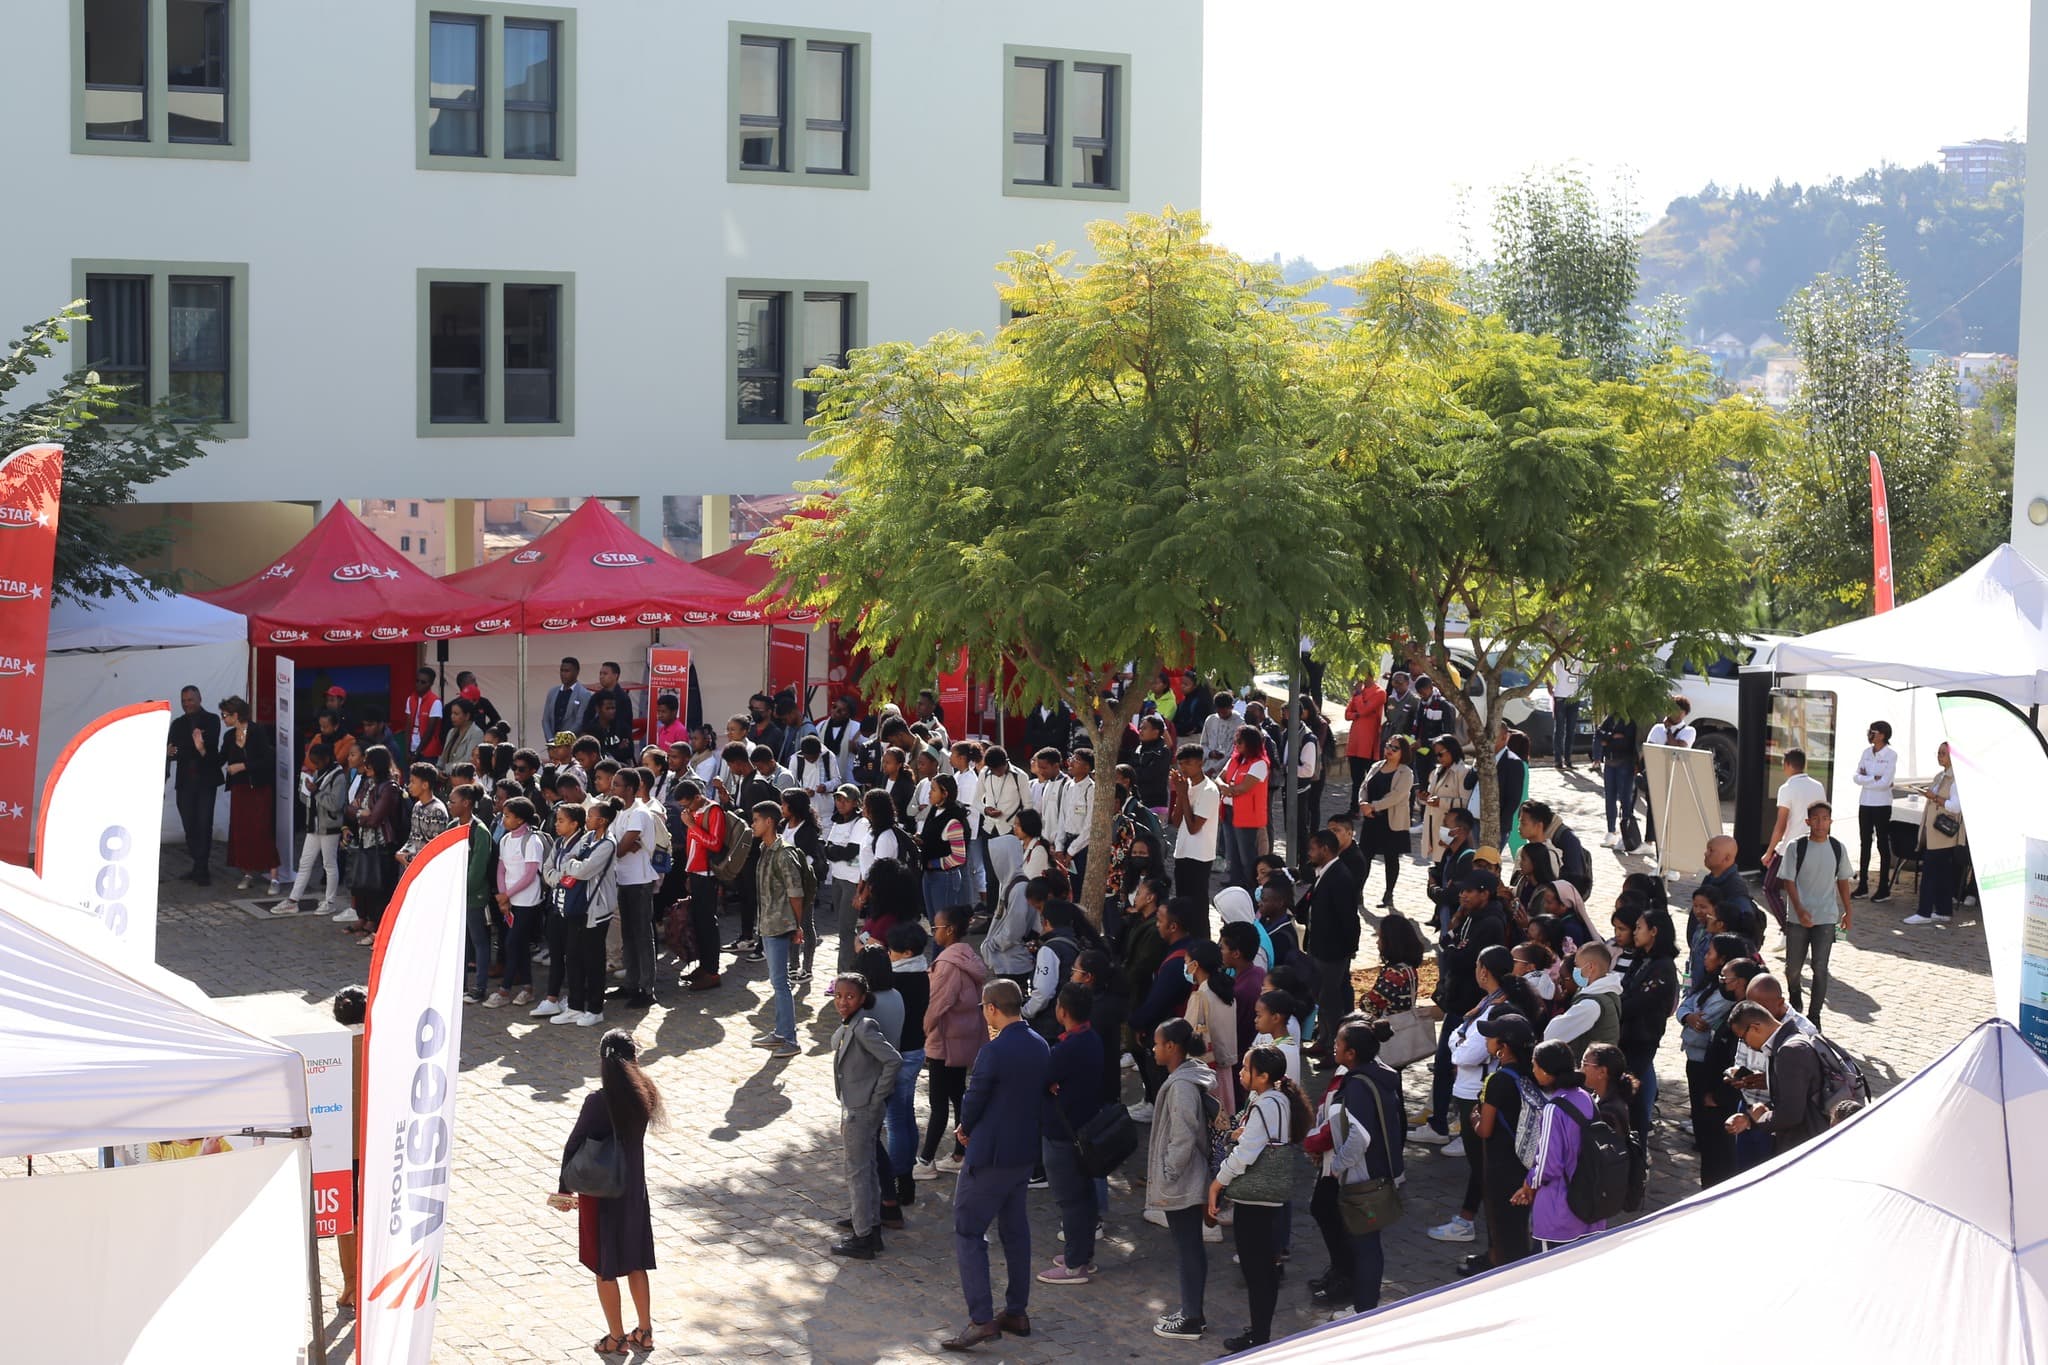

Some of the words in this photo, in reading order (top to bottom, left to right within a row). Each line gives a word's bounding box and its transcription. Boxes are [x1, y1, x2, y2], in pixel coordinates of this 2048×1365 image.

[0, 507, 32, 522] STAR
[602, 553, 638, 562] STAR
[343, 563, 380, 576] STAR
[642, 612, 661, 620] STAR
[688, 611, 708, 619] STAR
[733, 610, 751, 618] STAR
[596, 615, 616, 623] STAR
[480, 619, 501, 628] STAR
[378, 627, 398, 635] STAR
[430, 625, 451, 633] STAR
[276, 630, 298, 638] STAR
[330, 630, 352, 638] STAR
[389, 1119, 407, 1236] GROUPE
[313, 1188, 340, 1214] US
